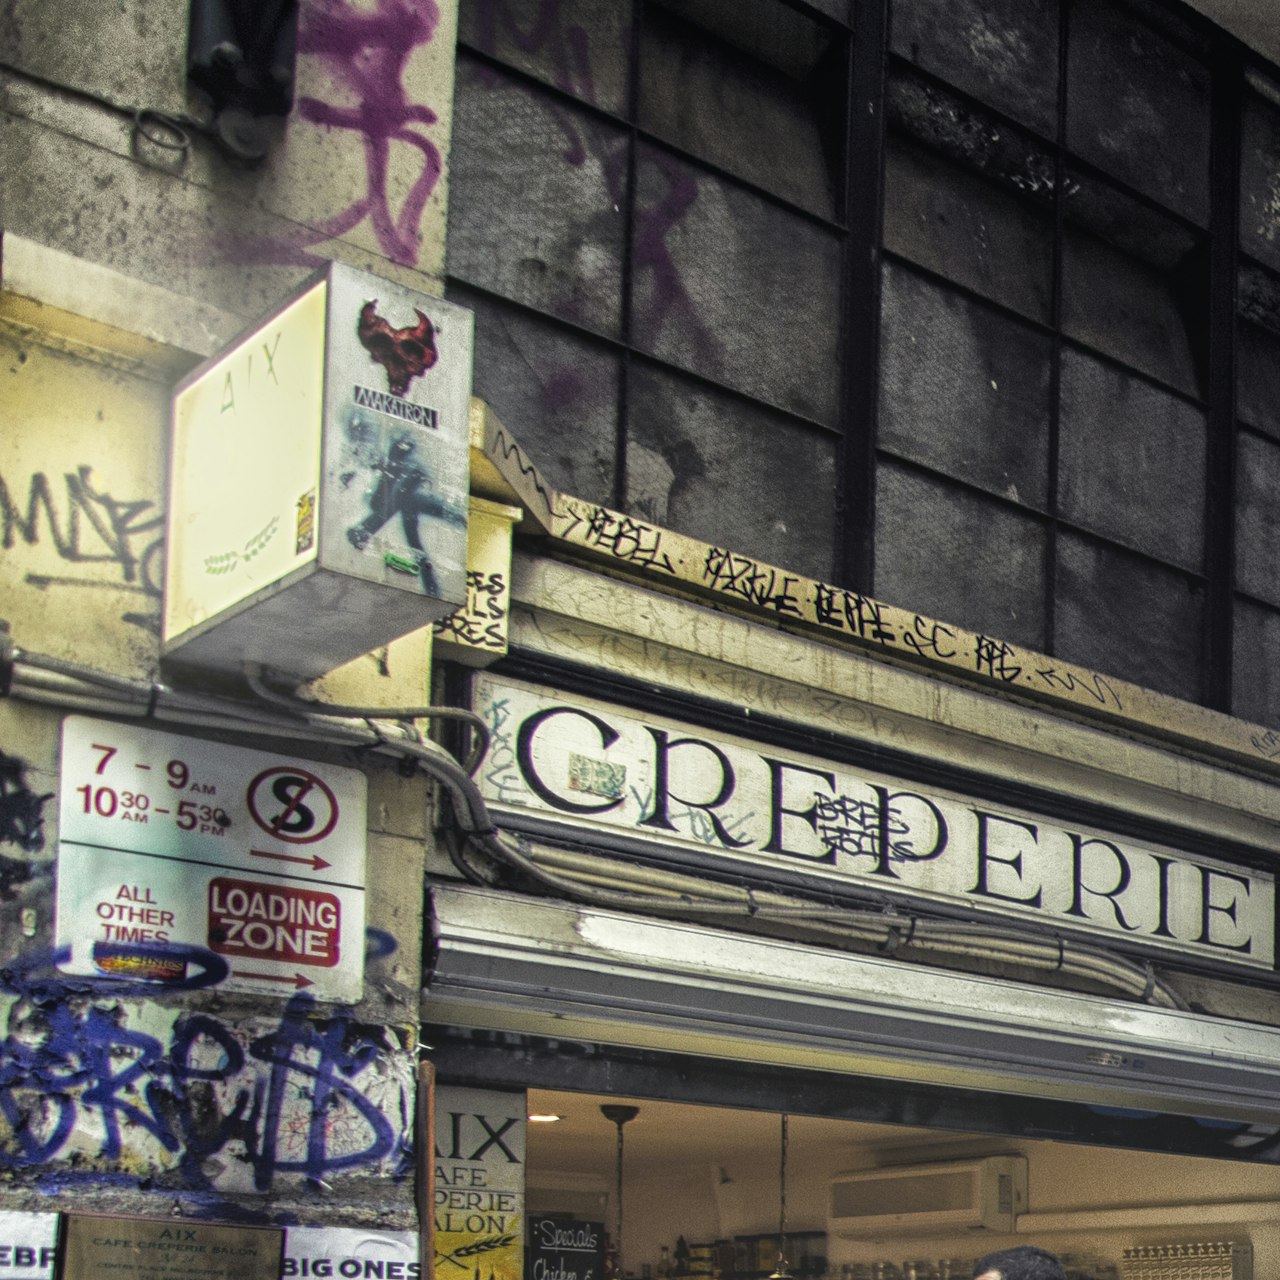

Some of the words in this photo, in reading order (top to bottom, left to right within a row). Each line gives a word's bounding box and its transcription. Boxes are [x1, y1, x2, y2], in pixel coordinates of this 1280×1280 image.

[91, 744, 117, 775] 7
[516, 706, 1252, 954] CREPERIE
[116, 884, 157, 905] ALL
[211, 886, 338, 930] LOADING
[97, 893, 174, 928] OTHER
[101, 923, 169, 946] TIMES
[218, 917, 329, 958] ZONE
[435, 1112, 522, 1164] IX
[93, 1238, 130, 1249] CAFE
[137, 1240, 208, 1254] CREPERIE
[213, 1247, 258, 1257] SALON
[159, 1228, 197, 1242] AIX
[281, 1257, 333, 1277] BIG
